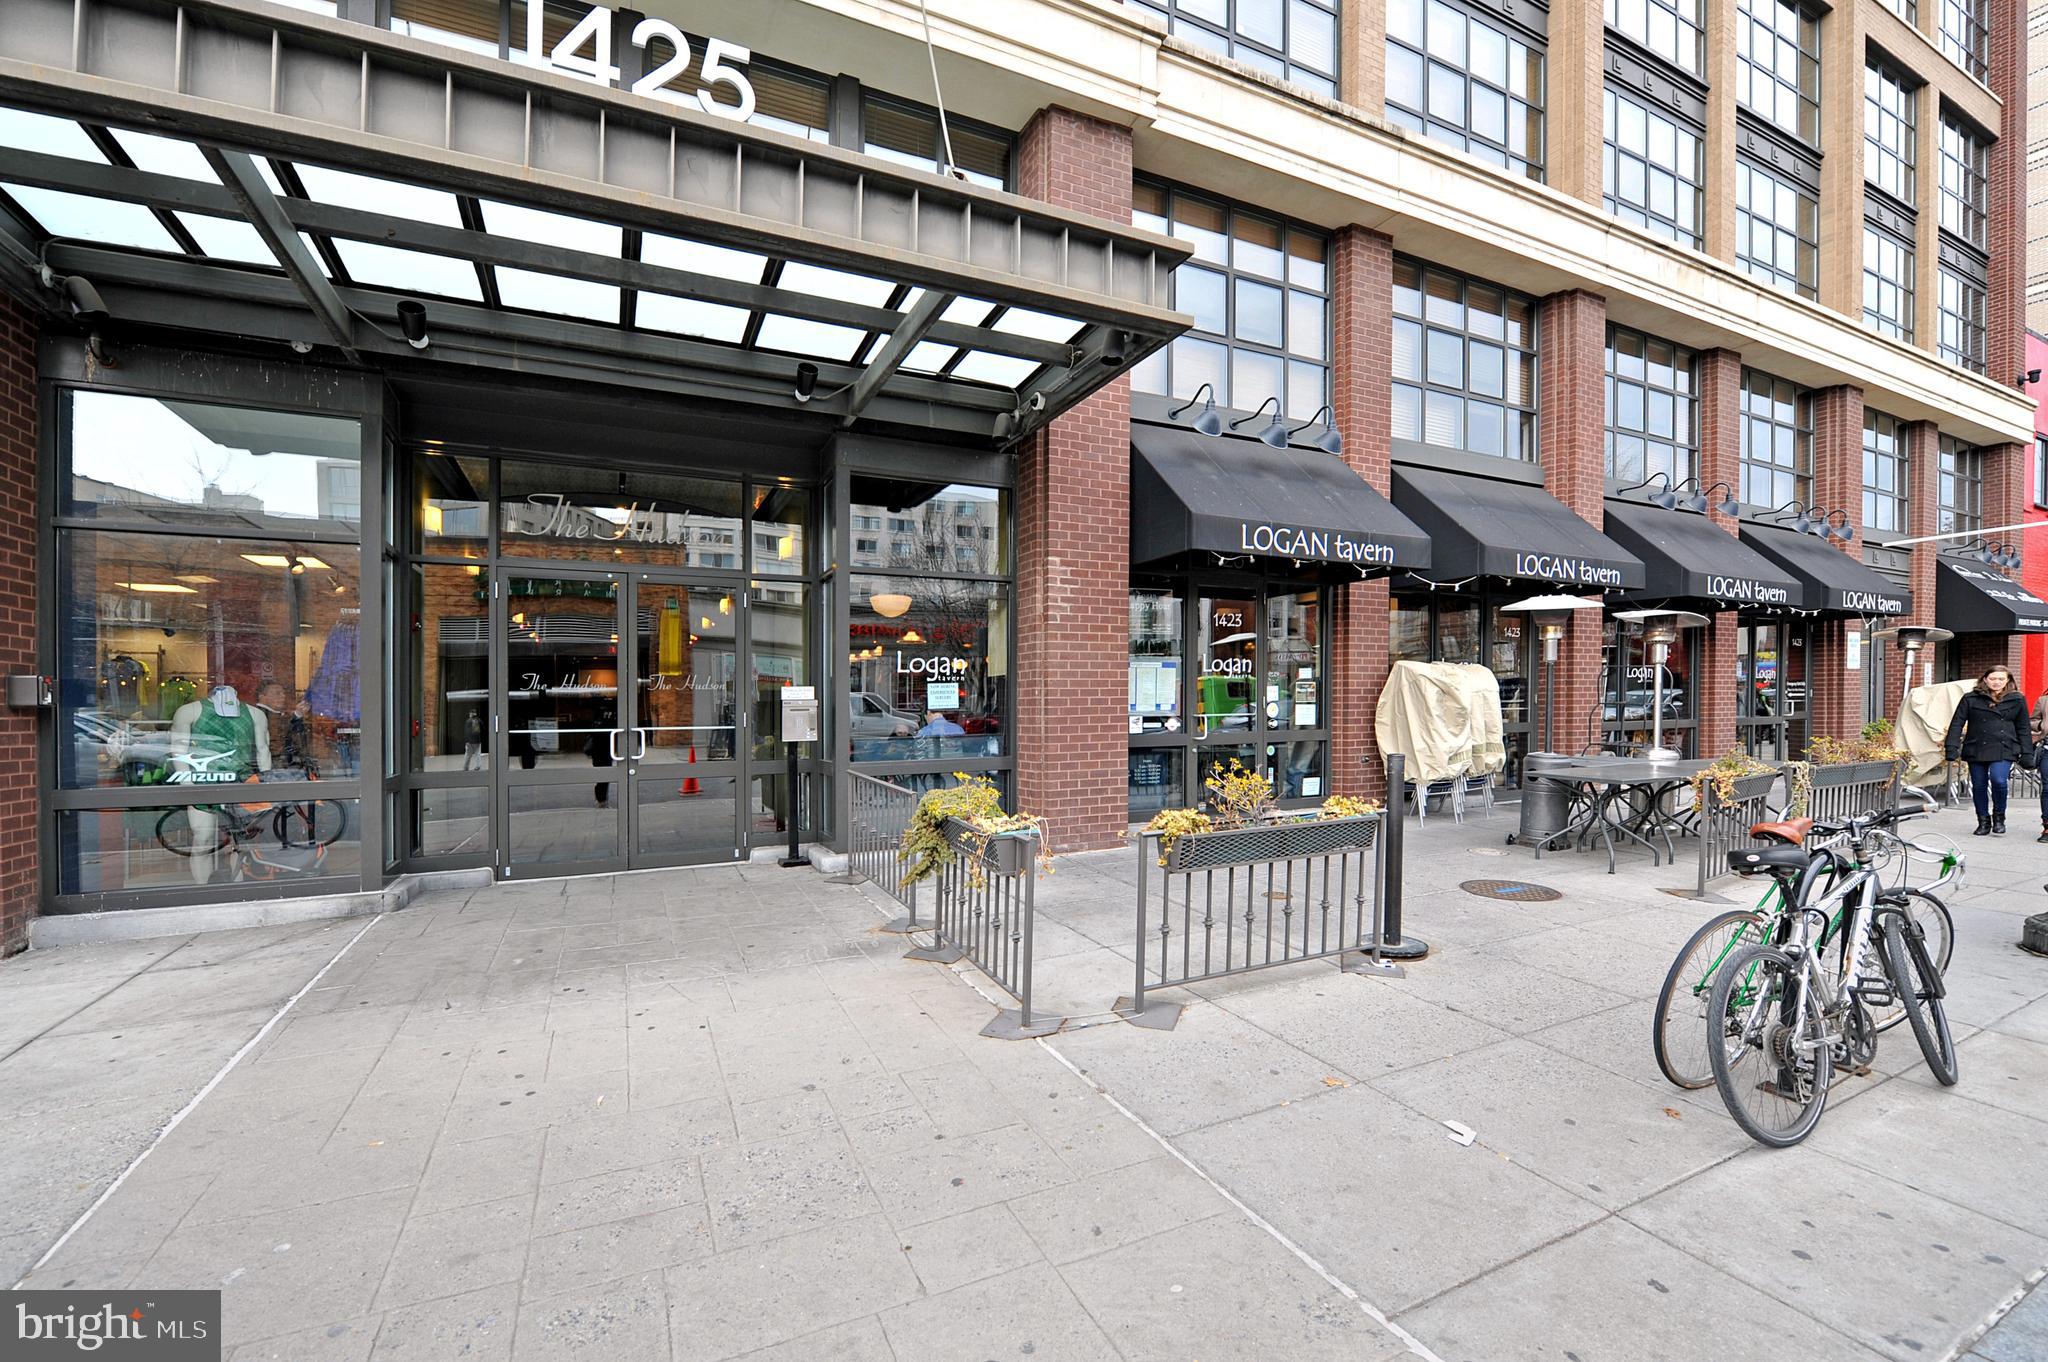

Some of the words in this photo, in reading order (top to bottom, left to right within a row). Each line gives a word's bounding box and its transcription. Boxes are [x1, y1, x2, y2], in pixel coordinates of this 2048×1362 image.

[527, 0, 756, 122] 1425
[521, 493, 590, 539] The
[594, 501, 726, 546] Hudson
[1241, 523, 1329, 558] LOGAN
[1334, 534, 1394, 564] tavern
[1516, 553, 1576, 580] LOGAN
[1579, 560, 1621, 585] tavern
[1707, 575, 1752, 599] LOGAN
[1754, 582, 1787, 603] tavern
[1842, 590, 1876, 610] LOGAN
[1877, 597, 1902, 613] tavern
[1213, 612, 1243, 628] 1423
[1503, 627, 1521, 638] 1423
[896, 650, 967, 682] Logan
[1202, 653, 1253, 679] Logan
[1755, 665, 1777, 683] Logan
[519, 673, 549, 691] The
[558, 673, 609, 691] Hudson
[647, 673, 673, 691] The
[675, 673, 726, 691] Hudson
